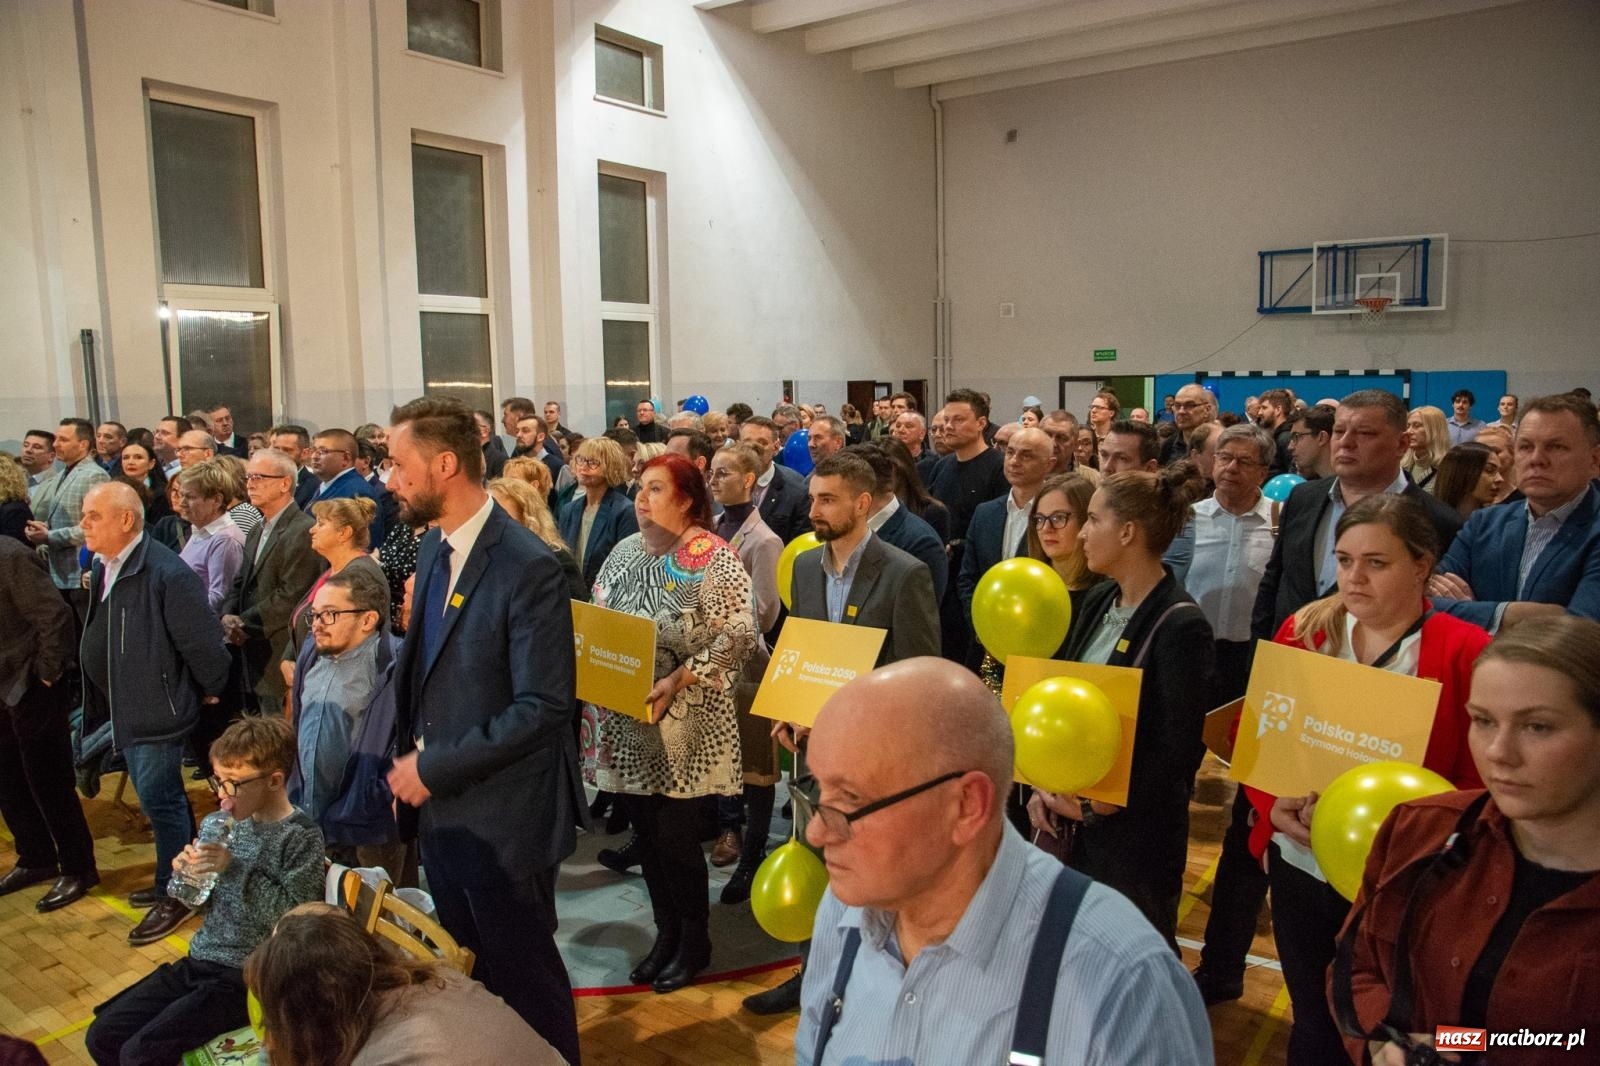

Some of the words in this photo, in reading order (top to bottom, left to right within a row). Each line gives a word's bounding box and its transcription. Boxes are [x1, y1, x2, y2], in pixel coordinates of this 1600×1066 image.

[590, 646, 618, 661] Polska
[619, 653, 642, 668] 2050
[802, 662, 831, 676] Polska
[831, 666, 857, 681] 2050
[1299, 733, 1345, 754] Szymona
[1303, 715, 1355, 743] Polska
[1358, 732, 1403, 758] 2050
